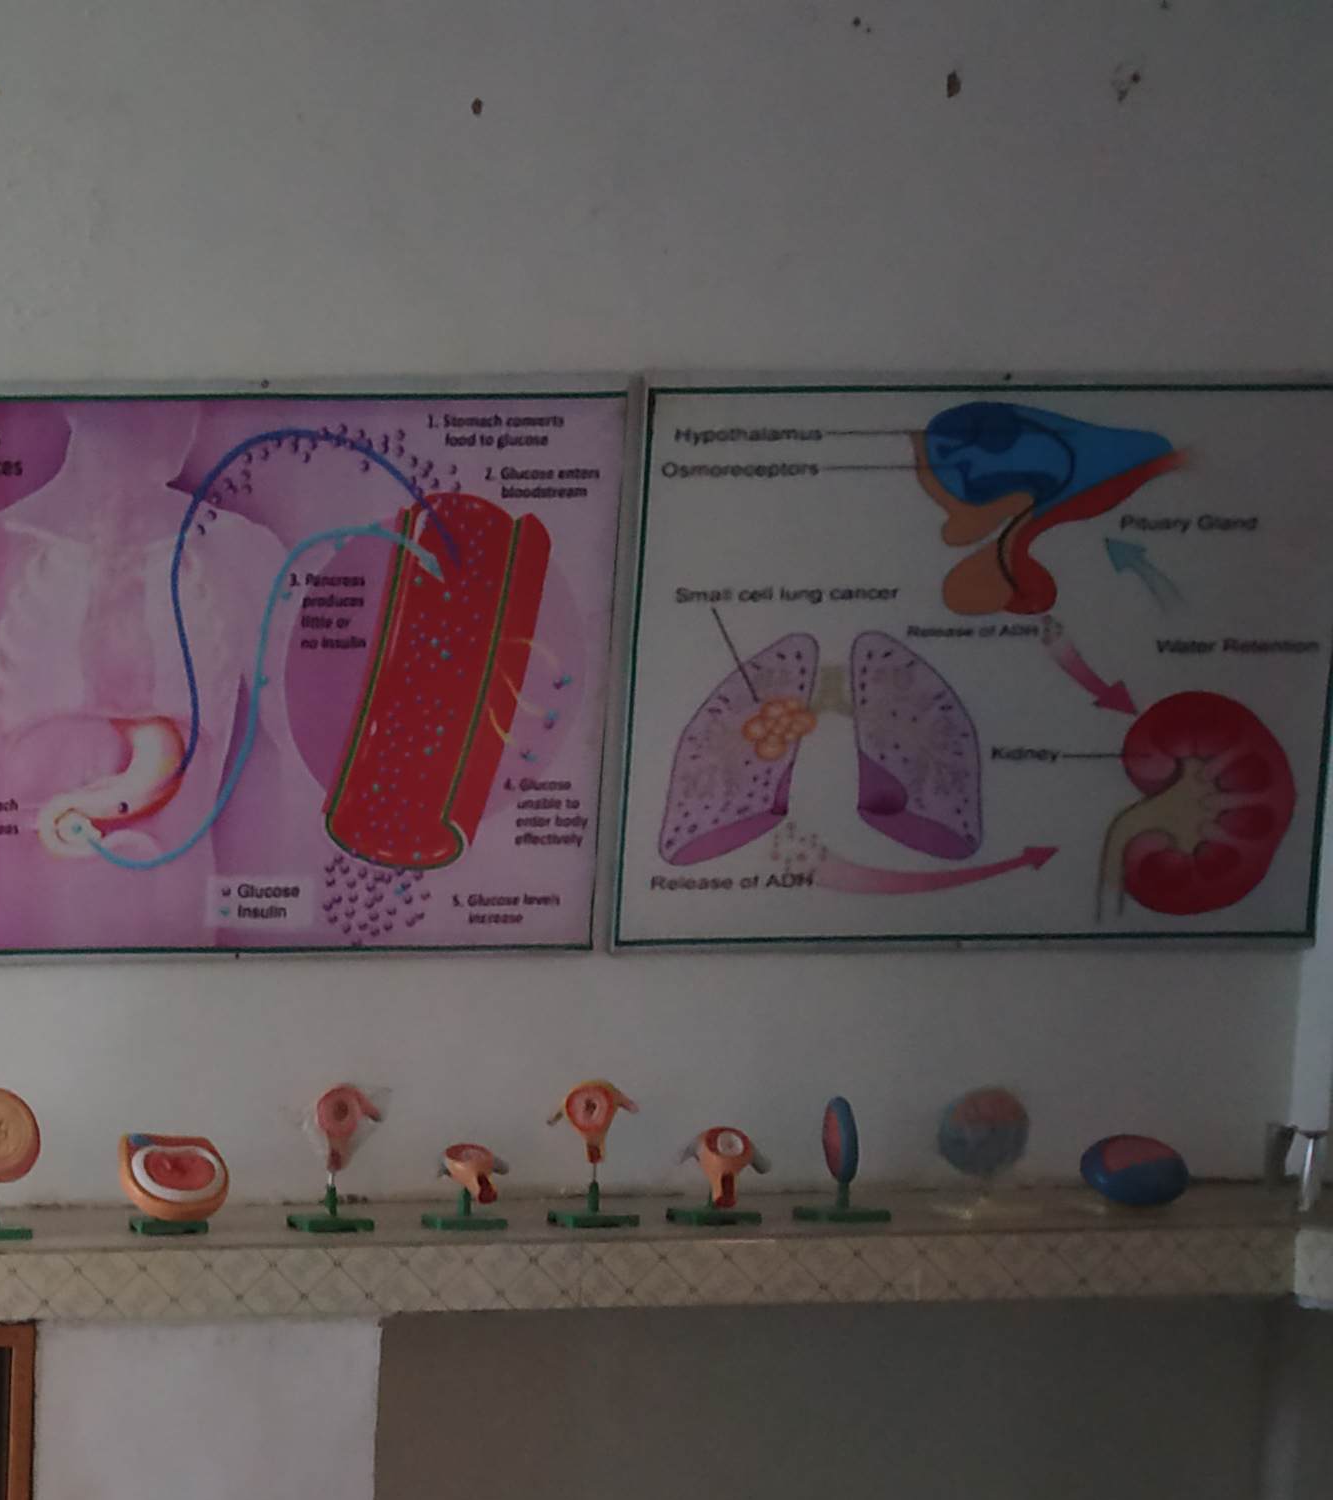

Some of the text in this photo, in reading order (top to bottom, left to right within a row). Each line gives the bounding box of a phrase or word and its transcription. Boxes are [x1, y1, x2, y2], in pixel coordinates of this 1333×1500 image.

[428, 414, 564, 428] 1. Stomach converts
[445, 434, 548, 449] food to glucose
[675, 428, 823, 445] Hypothalamus
[500, 467, 554, 480] Glucose
[558, 469, 600, 479] enters
[661, 461, 819, 478] Osmoreceptors
[501, 487, 588, 498] bloodstream
[1197, 514, 1259, 530] Gland
[305, 573, 365, 588] Pancreas
[302, 595, 364, 609] produces
[675, 587, 899, 604] Small cell lung cancer
[301, 616, 351, 629] little or
[907, 625, 974, 638] Release
[978, 625, 996, 638] of
[301, 637, 366, 649] no insulin
[1156, 639, 1319, 653] Water Retention
[991, 746, 1060, 762] Kidney
[519, 778, 572, 791] Glucose
[517, 799, 580, 810] unable to
[516, 816, 588, 830] enter body
[515, 833, 582, 847] effectively
[650, 876, 733, 890] Release
[739, 875, 759, 890] of
[237, 883, 300, 898] Glucose
[467, 894, 519, 906] Glucose
[523, 894, 561, 906] levels
[237, 904, 287, 919] Insulin
[468, 914, 523, 924] increase
